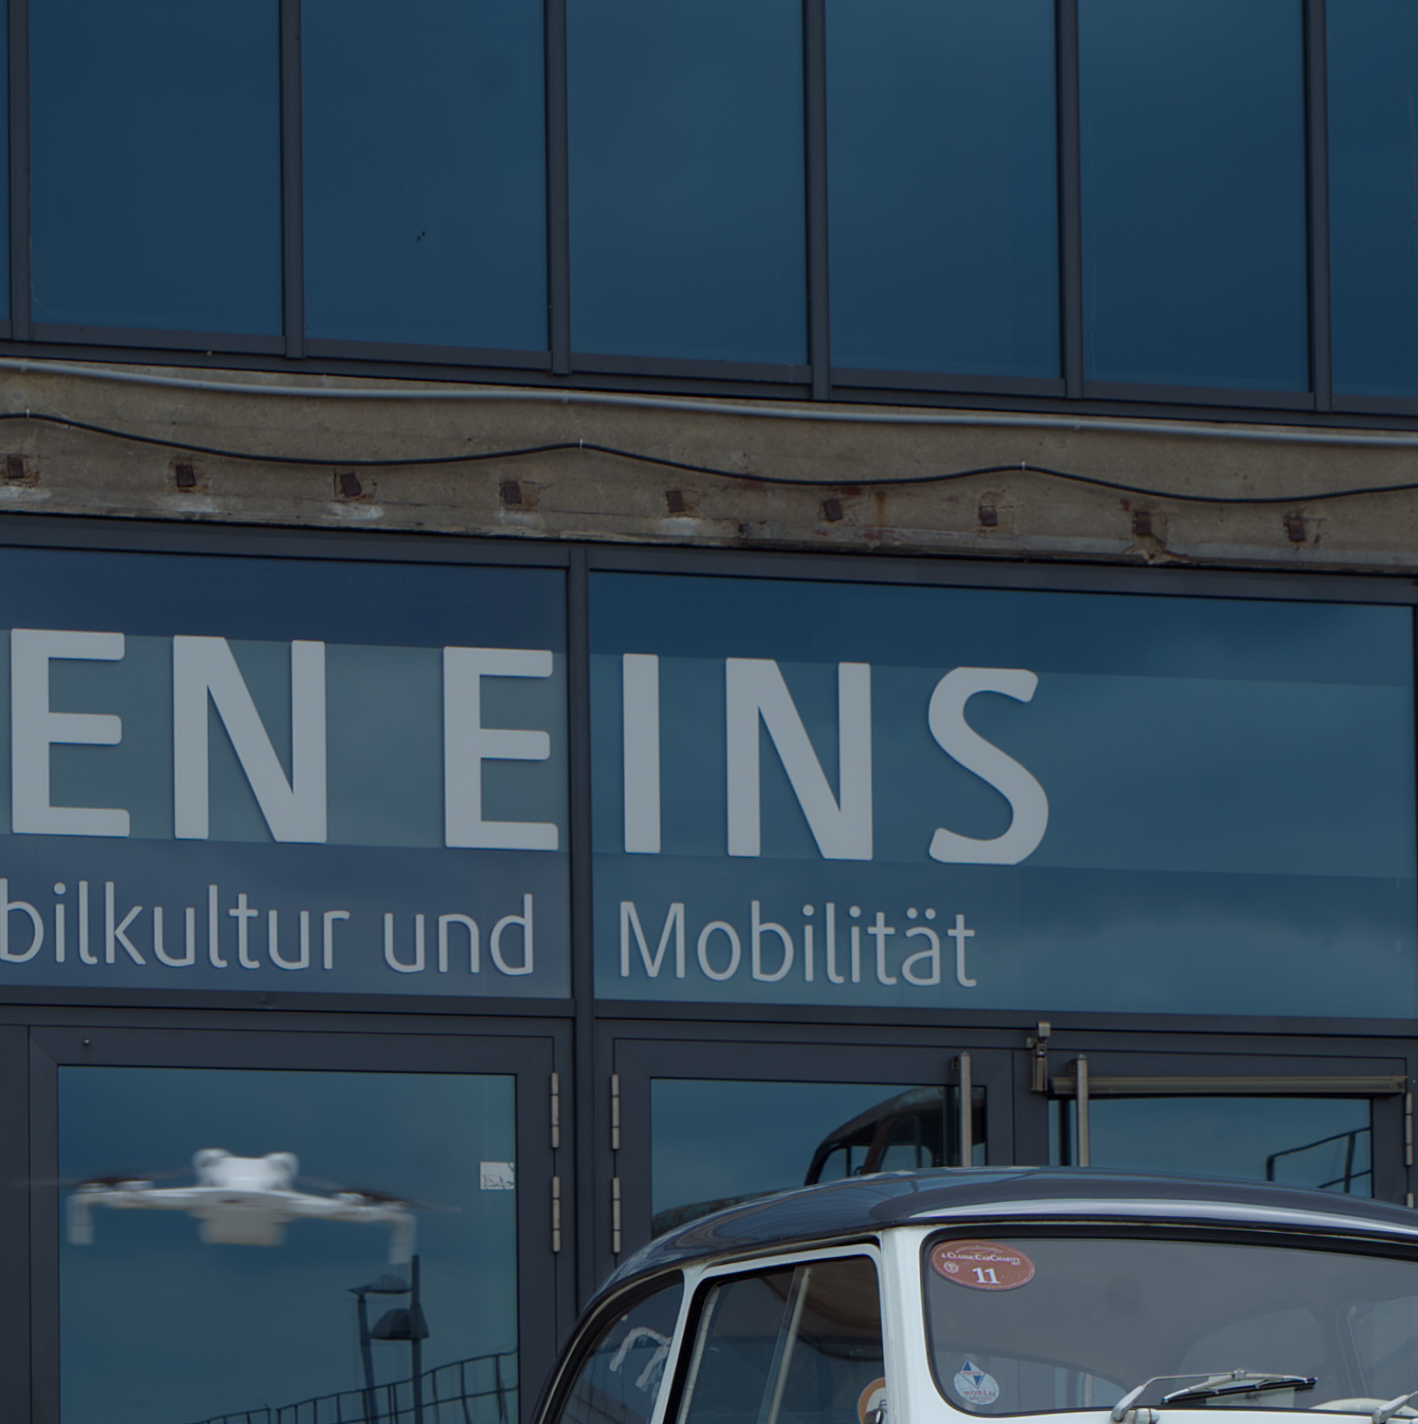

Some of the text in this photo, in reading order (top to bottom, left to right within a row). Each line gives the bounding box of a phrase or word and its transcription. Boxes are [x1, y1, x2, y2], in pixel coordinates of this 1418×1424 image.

[443, 646, 1050, 865] EINS
[384, 893, 534, 977] und
[619, 900, 977, 988] Mobilität
[972, 1267, 1000, 1284] 11
